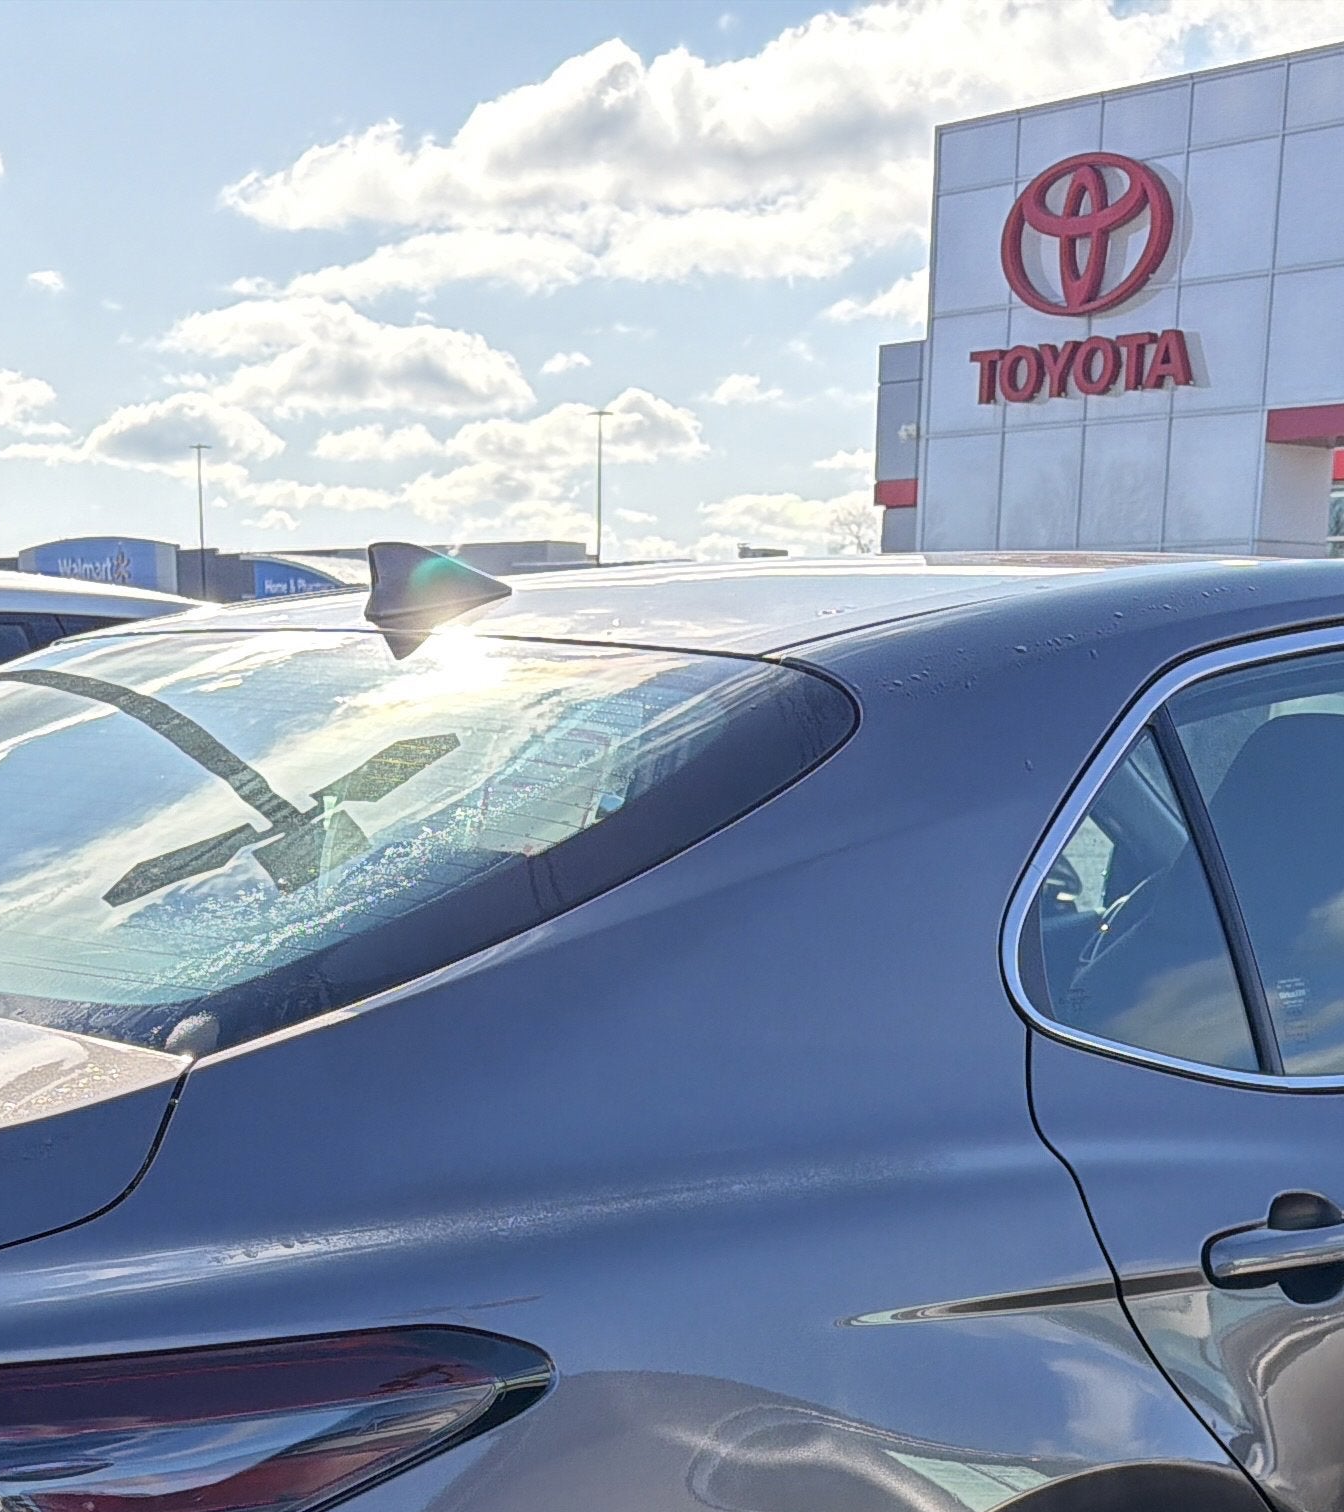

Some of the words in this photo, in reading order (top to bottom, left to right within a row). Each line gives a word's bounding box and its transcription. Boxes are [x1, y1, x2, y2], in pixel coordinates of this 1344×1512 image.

[970, 330, 1193, 405] TOYOTA
[58, 558, 113, 581] Walmart
[264, 579, 288, 595] Home
